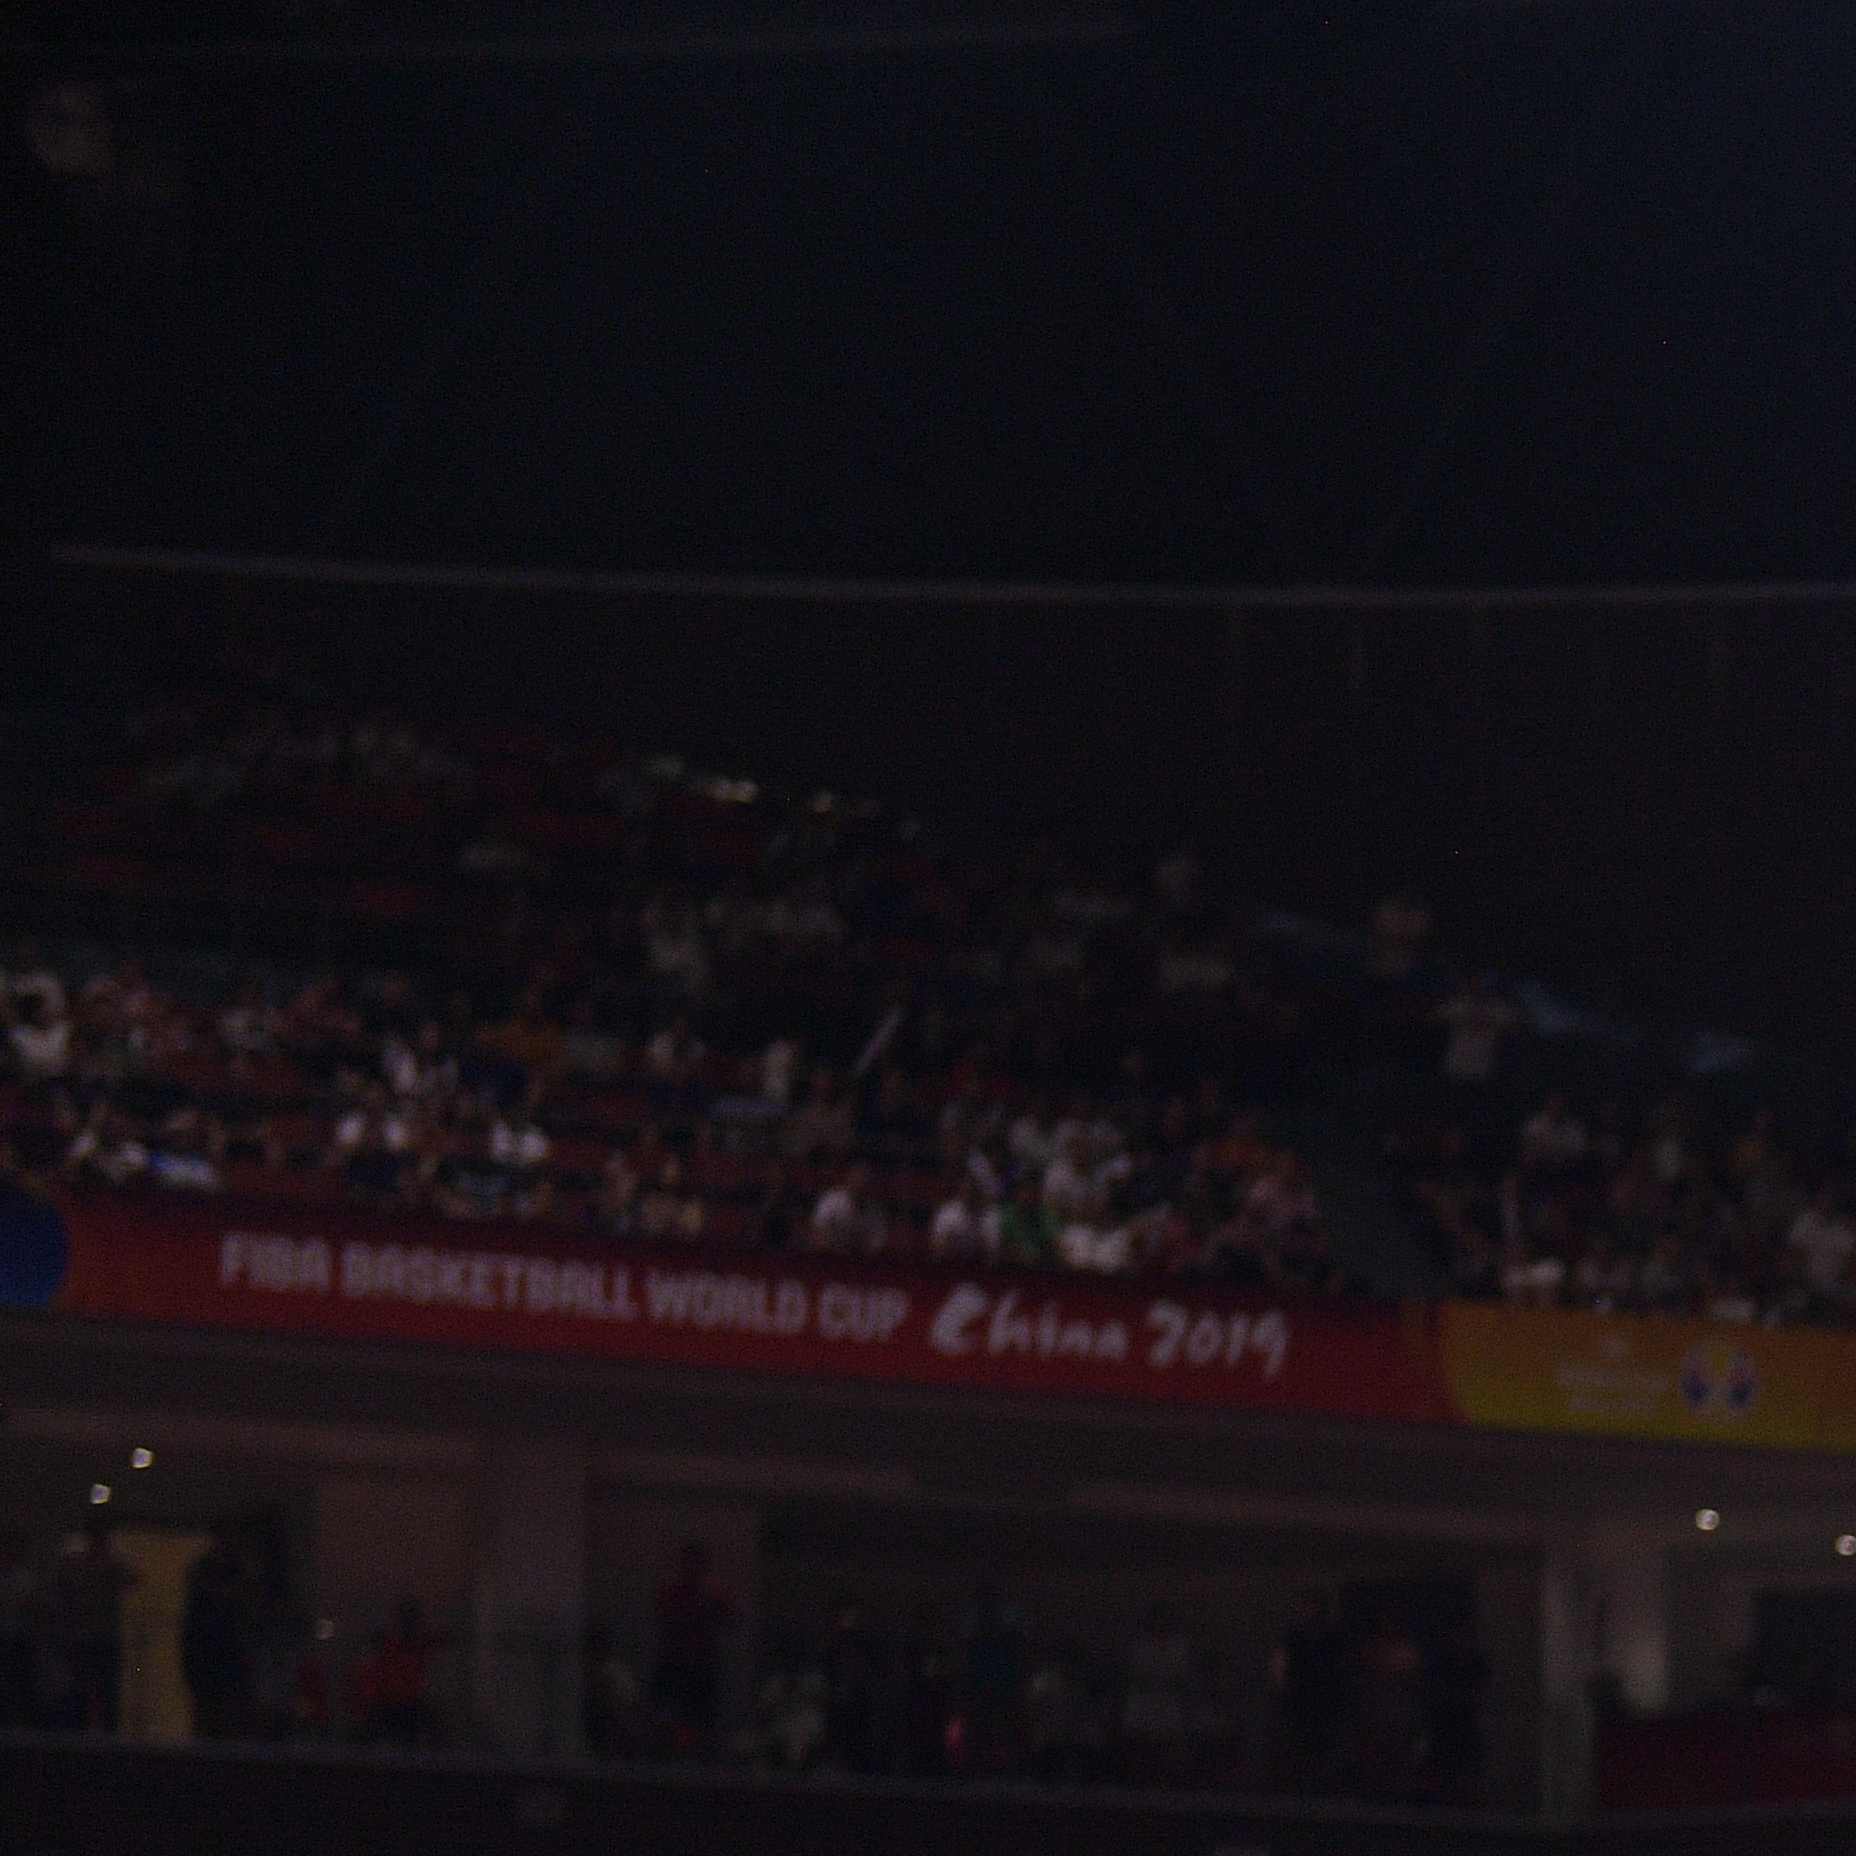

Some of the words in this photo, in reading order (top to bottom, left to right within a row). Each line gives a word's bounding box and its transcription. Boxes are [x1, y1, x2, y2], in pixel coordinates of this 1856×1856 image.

[221, 1230, 331, 1292] FIBA
[342, 1240, 638, 1322] BASKETBALL
[646, 1268, 808, 1336] WORLD
[818, 1281, 909, 1342] CUP
[931, 1280, 1130, 1358] China
[1146, 1298, 1290, 1379] 2019
